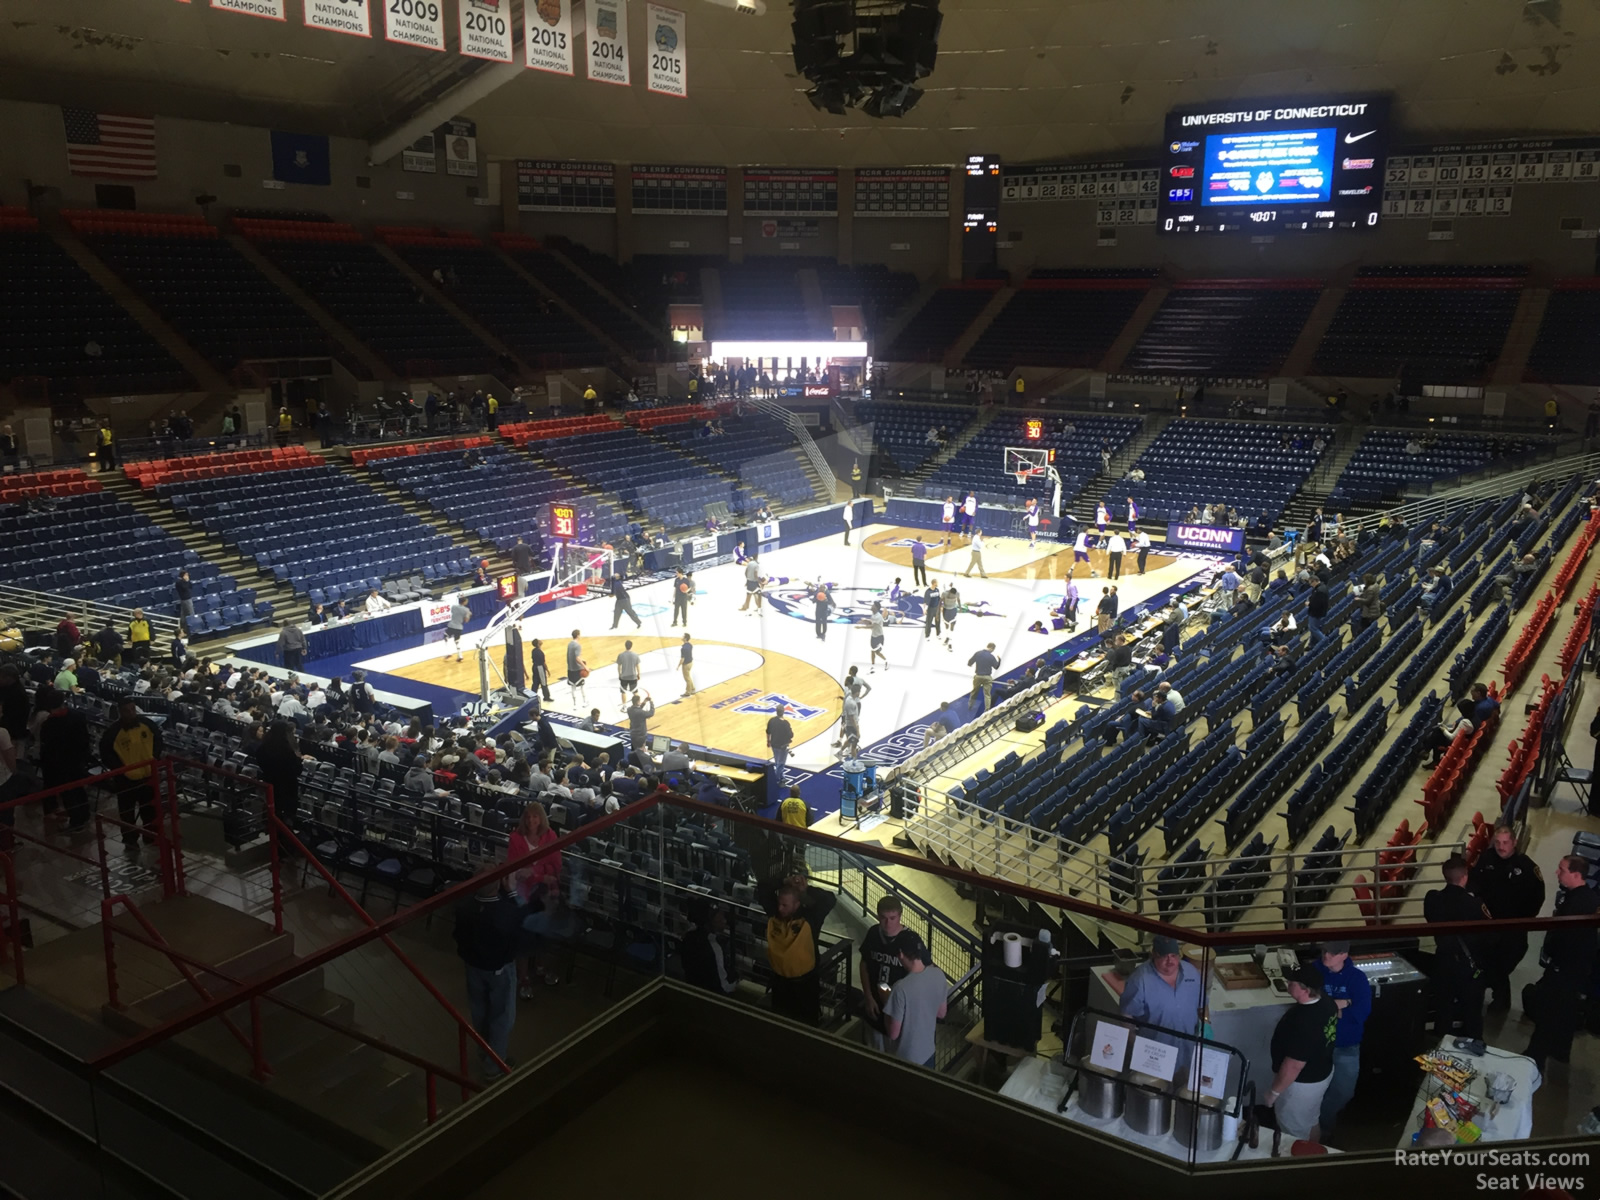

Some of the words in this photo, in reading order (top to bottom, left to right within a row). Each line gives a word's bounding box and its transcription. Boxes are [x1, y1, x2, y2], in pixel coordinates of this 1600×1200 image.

[220, 0, 277, 16] CHAMPIONS
[315, 3, 359, 19] NATIONAL
[390, 0, 438, 22] 2009
[312, 15, 363, 32] CHAMPIONS
[395, 19, 435, 34] NATIONAL
[466, 12, 505, 35] 2010
[393, 30, 438, 46] CHAMPIONS
[468, 34, 504, 47] NATIONAL
[531, 27, 566, 49] 2013
[467, 45, 508, 59] CHAMPIONS
[534, 48, 565, 60] NATIONAL
[592, 41, 624, 61] 2014
[531, 58, 568, 71] CHAMPIONS
[594, 61, 623, 72] NATIONAL
[652, 54, 680, 74] 2015
[592, 70, 626, 82] CHAMPIONS
[654, 73, 680, 84] NATIONAL
[652, 82, 682, 94] CHAMPIONS
[1182, 111, 1252, 126] UNIVERSITY
[1255, 110, 1272, 121] OF
[1274, 104, 1368, 120] CONNECTICUT
[1440, 168, 1458, 179] 00
[1468, 168, 1484, 178] 13
[1494, 167, 1512, 177] 42
[1524, 165, 1536, 177] 34
[1553, 164, 1564, 176] 32
[1581, 163, 1592, 175] 50
[1389, 170, 1406, 181] 52
[1028, 187, 1032, 196] 9
[1042, 186, 1056, 195] 22
[1062, 185, 1075, 195] 25
[1081, 184, 1095, 194] 42
[1101, 183, 1115, 193] 44
[1142, 182, 1157, 191] 42
[1007, 188, 1015, 197] C
[1390, 202, 1398, 212] 15
[1414, 201, 1424, 212] 22
[1466, 200, 1477, 211] 42
[1494, 199, 1504, 210] 13
[1102, 211, 1112, 221] 13
[1120, 211, 1133, 220] 22
[1250, 211, 1277, 222] 40:07
[1367, 212, 1378, 226] 0
[1165, 218, 1174, 231] 0
[1029, 427, 1040, 438] 30
[554, 508, 573, 518] 40:07
[557, 517, 572, 534] 30
[1177, 526, 1233, 543] UCONN
[1184, 540, 1222, 549] BASKETBALL
[503, 585, 512, 596] 30
